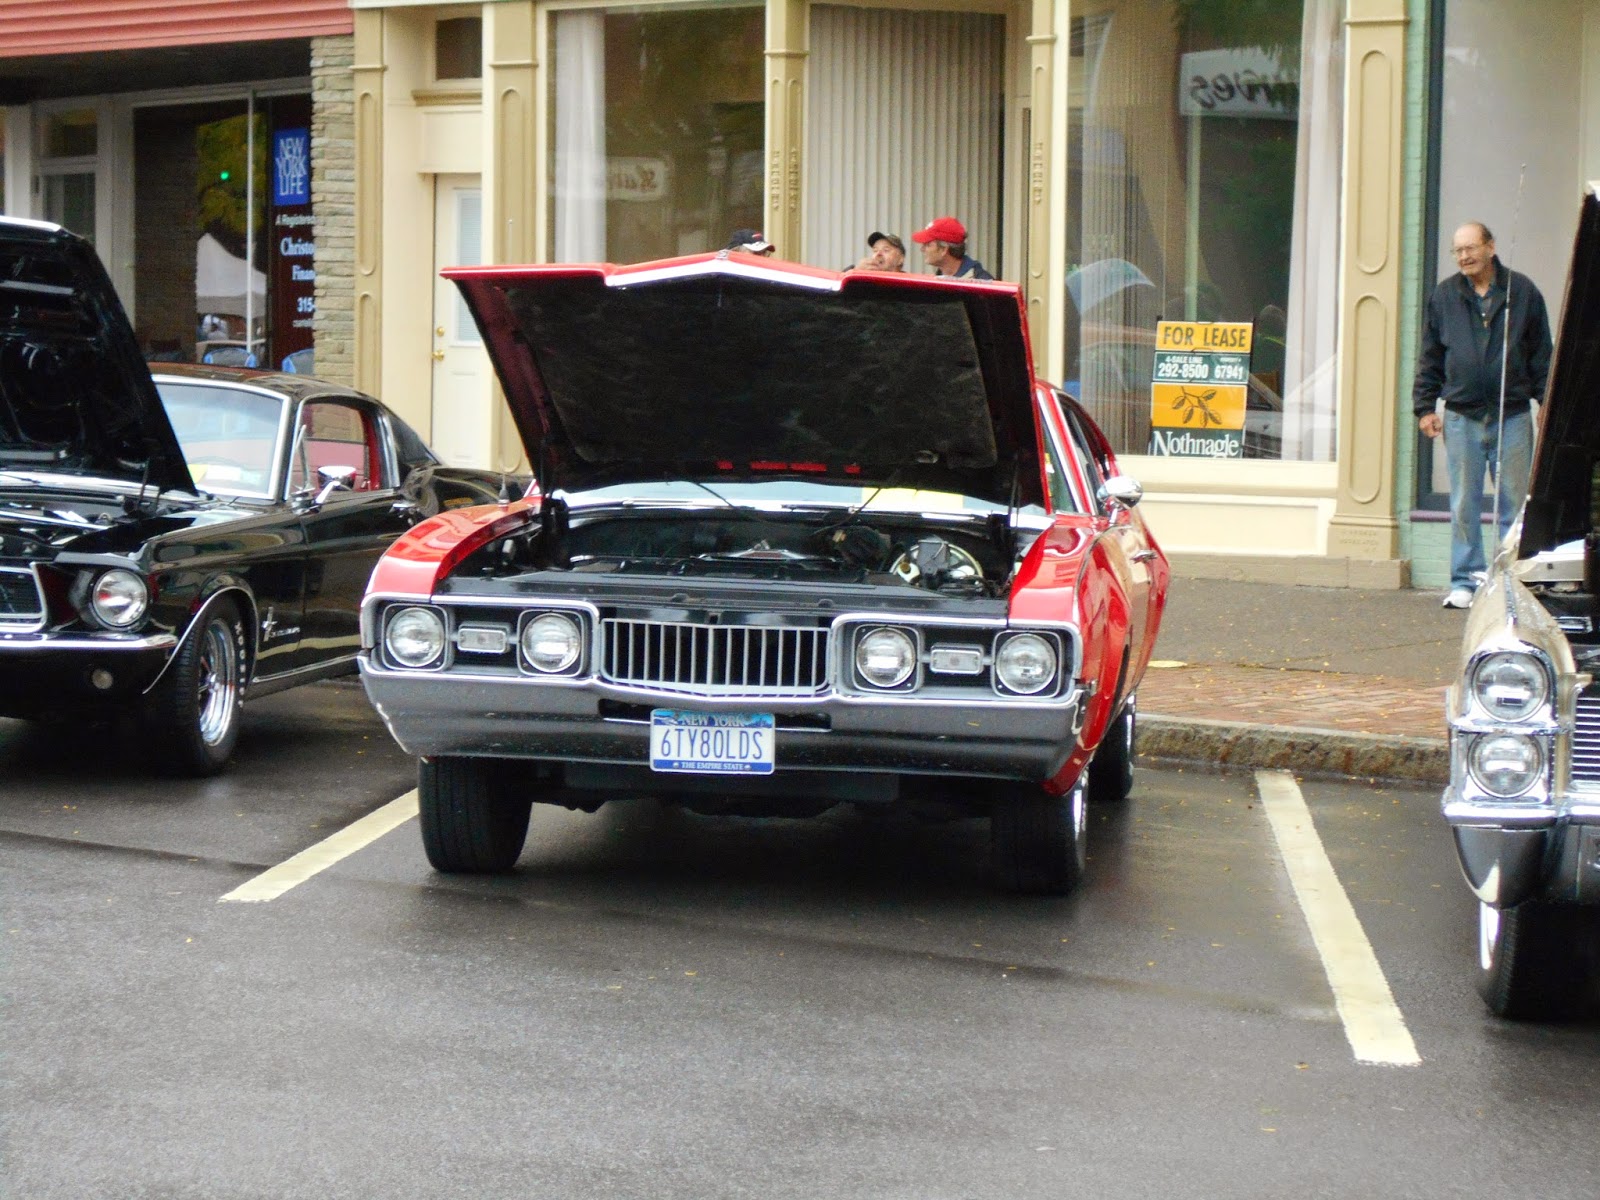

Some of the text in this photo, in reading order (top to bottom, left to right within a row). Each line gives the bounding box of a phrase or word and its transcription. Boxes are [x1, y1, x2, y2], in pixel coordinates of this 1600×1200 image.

[280, 137, 304, 158] NEW
[275, 155, 307, 175] YORK
[280, 174, 304, 195] LIFE
[1163, 326, 1247, 348] FOR LEASE
[1158, 363, 1209, 379] 292-8500
[1214, 365, 1244, 380] 67941
[1153, 430, 1239, 458] Nothnagle
[681, 714, 745, 728] NEW YORK
[681, 761, 744, 771] THE EMPIRE STATE
